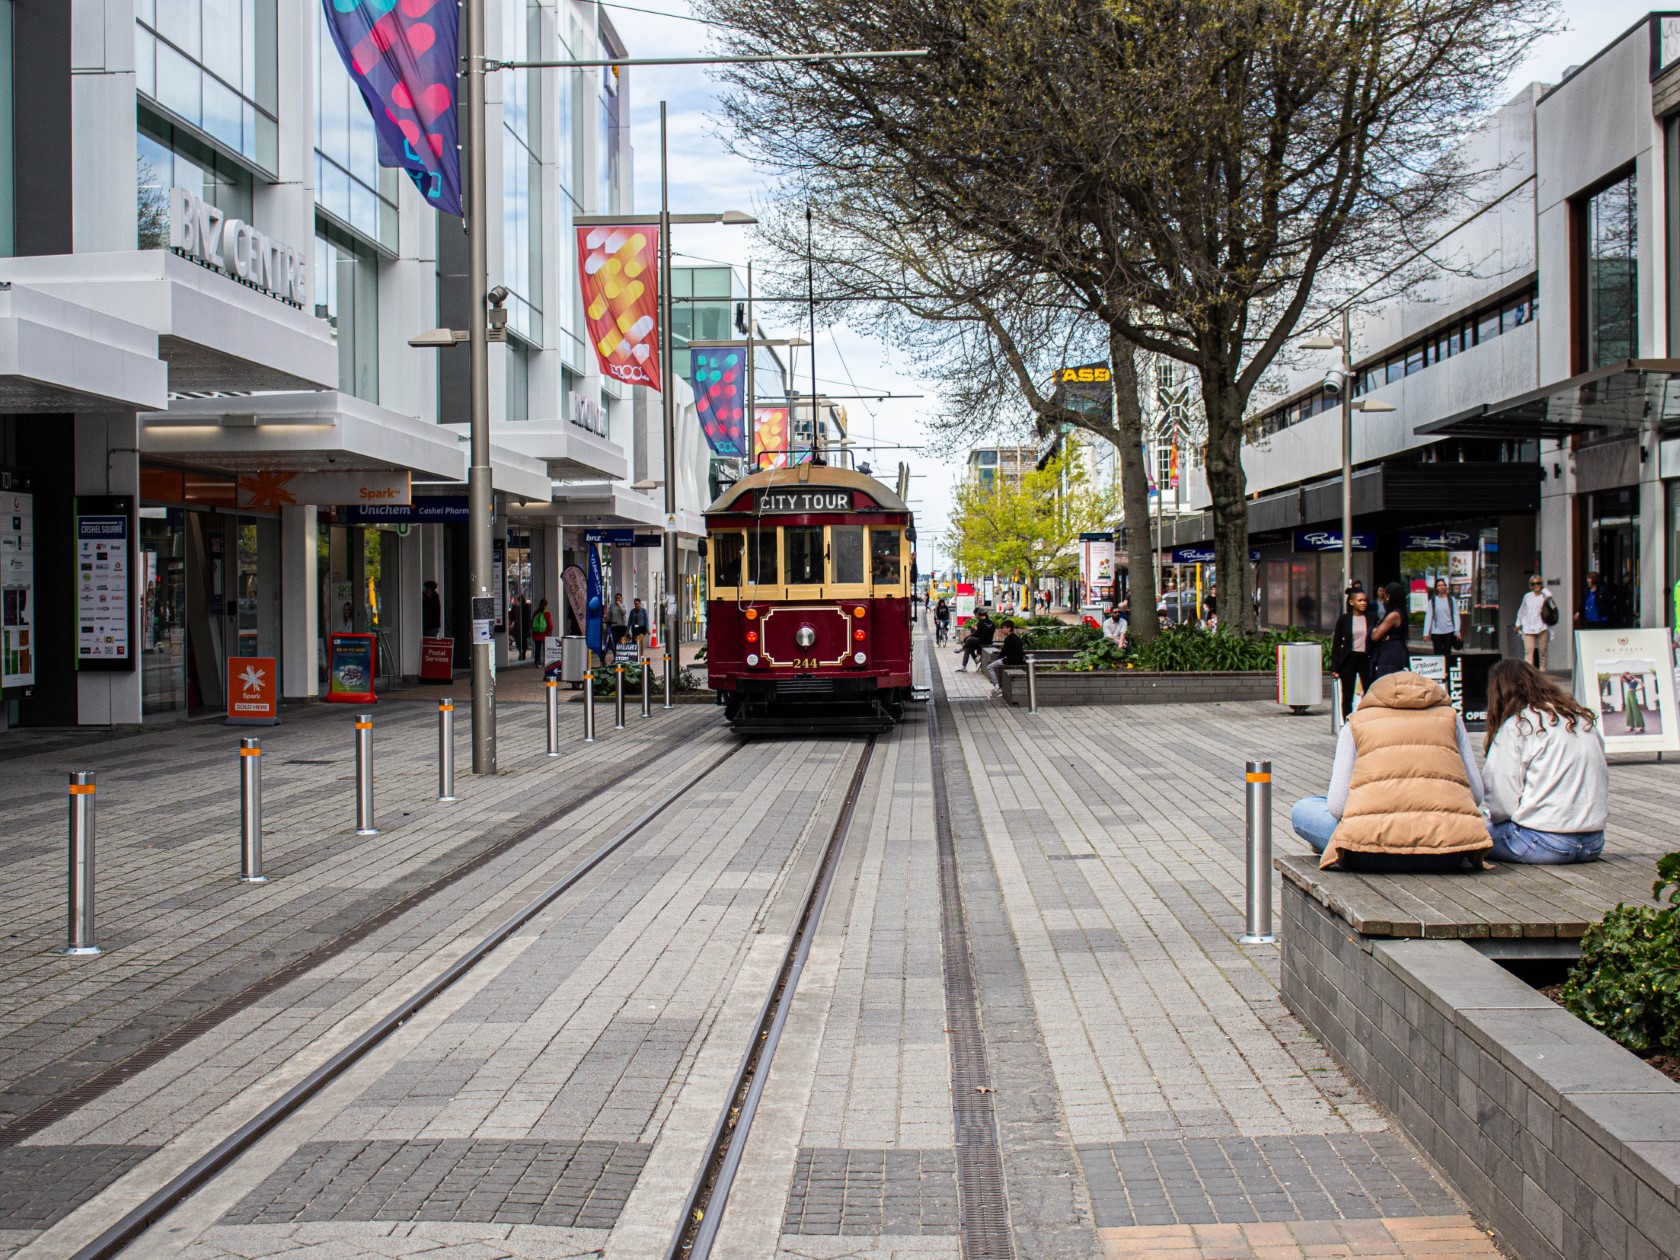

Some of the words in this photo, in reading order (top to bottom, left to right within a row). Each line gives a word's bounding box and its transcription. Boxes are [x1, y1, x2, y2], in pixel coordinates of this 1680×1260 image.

[169, 187, 223, 268] BNZ
[223, 219, 306, 306] CENTRE
[1062, 367, 1110, 383] ASB
[359, 487, 394, 500] Spark
[760, 494, 798, 509] CITY
[801, 493, 849, 508] TOUR
[418, 507, 444, 515] Cashel
[445, 507, 469, 515] Pharm
[81, 525, 101, 534] CASHEL
[101, 525, 123, 534] SQUARE
[585, 533, 602, 542] bnz
[425, 655, 449, 663] Services
[793, 658, 819, 669] 244
[242, 692, 261, 700] Spark
[1465, 711, 1488, 721] OPE
